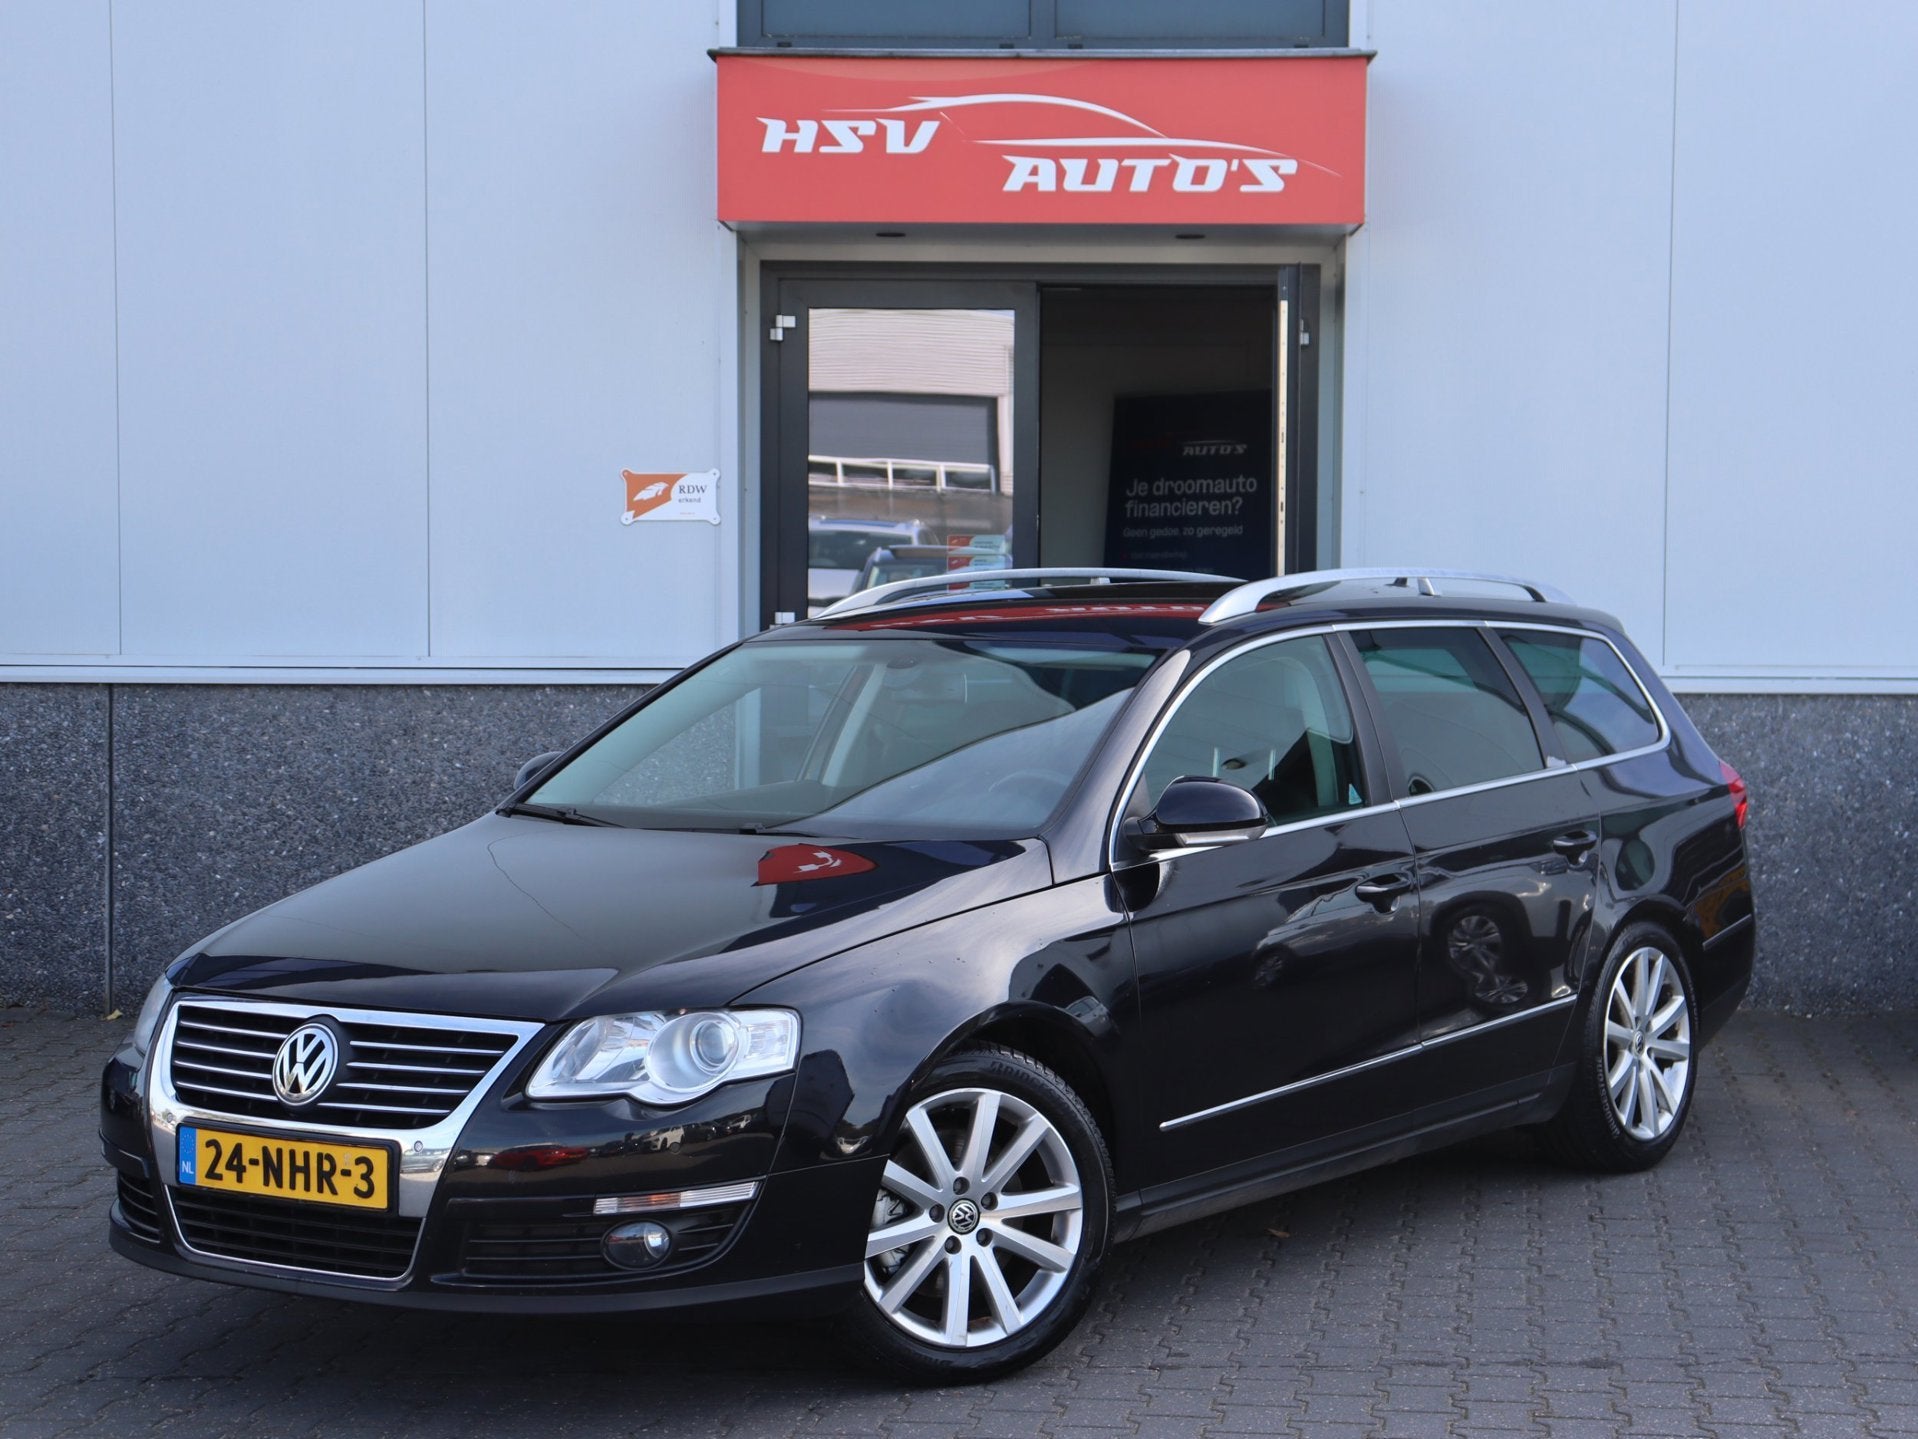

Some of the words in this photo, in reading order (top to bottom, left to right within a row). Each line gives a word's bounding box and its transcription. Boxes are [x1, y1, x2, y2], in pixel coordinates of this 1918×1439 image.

[756, 116, 941, 154] HSV
[1002, 152, 1298, 193] AUTO'S
[678, 484, 708, 494] RDW
[1125, 478, 1149, 497] Je
[1152, 474, 1258, 496] droomauto
[1124, 496, 1243, 518] financieren?
[1196, 524, 1244, 538] geregeld
[181, 1161, 195, 1175] NL
[204, 1137, 376, 1200] 24-NHR-3
